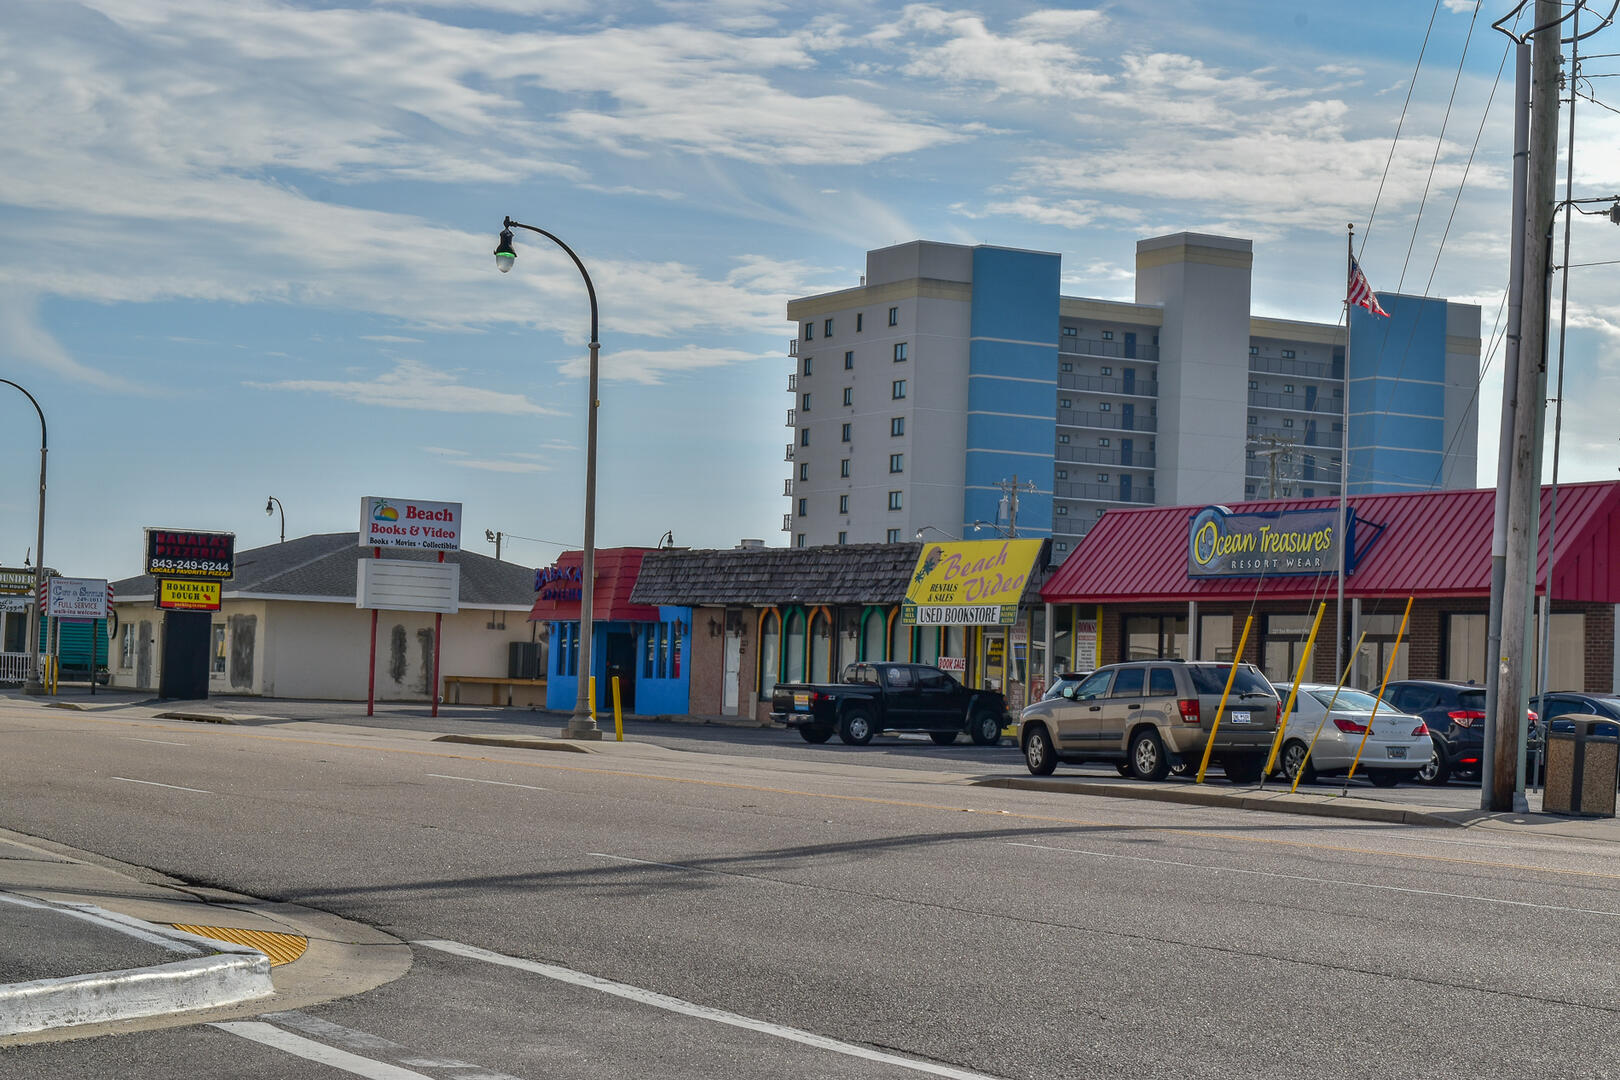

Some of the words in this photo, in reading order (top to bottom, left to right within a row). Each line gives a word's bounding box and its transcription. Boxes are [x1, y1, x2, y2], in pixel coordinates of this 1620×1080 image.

[405, 505, 454, 522] Beach
[371, 522, 407, 536] Books
[409, 525, 420, 537] &
[422, 526, 456, 540] Video
[369, 536, 389, 546] Books
[394, 538, 416, 548] Movies
[422, 541, 458, 551] Collectibles
[1193, 521, 1257, 565] Ocean
[1259, 524, 1333, 553] Treasures
[156, 545, 227, 559] PIZZERIA
[152, 559, 230, 573] 843-249-6244
[941, 542, 1009, 581] Beach
[1231, 559, 1278, 569] RESORT
[1286, 558, 1321, 568] WEAR
[176, 569, 208, 577] FAVORITE
[166, 583, 217, 594] HOMEMADE
[929, 583, 959, 592] RENTALS
[963, 573, 1025, 602] Video
[172, 592, 201, 601] DOUGH
[933, 592, 955, 602] SALES
[58, 601, 73, 609] FULL
[74, 602, 97, 610] SERVICE
[919, 607, 943, 623] USED
[944, 606, 998, 623] BOOKSTORE
[938, 657, 953, 670] BOOK
[953, 657, 965, 670] SALE
